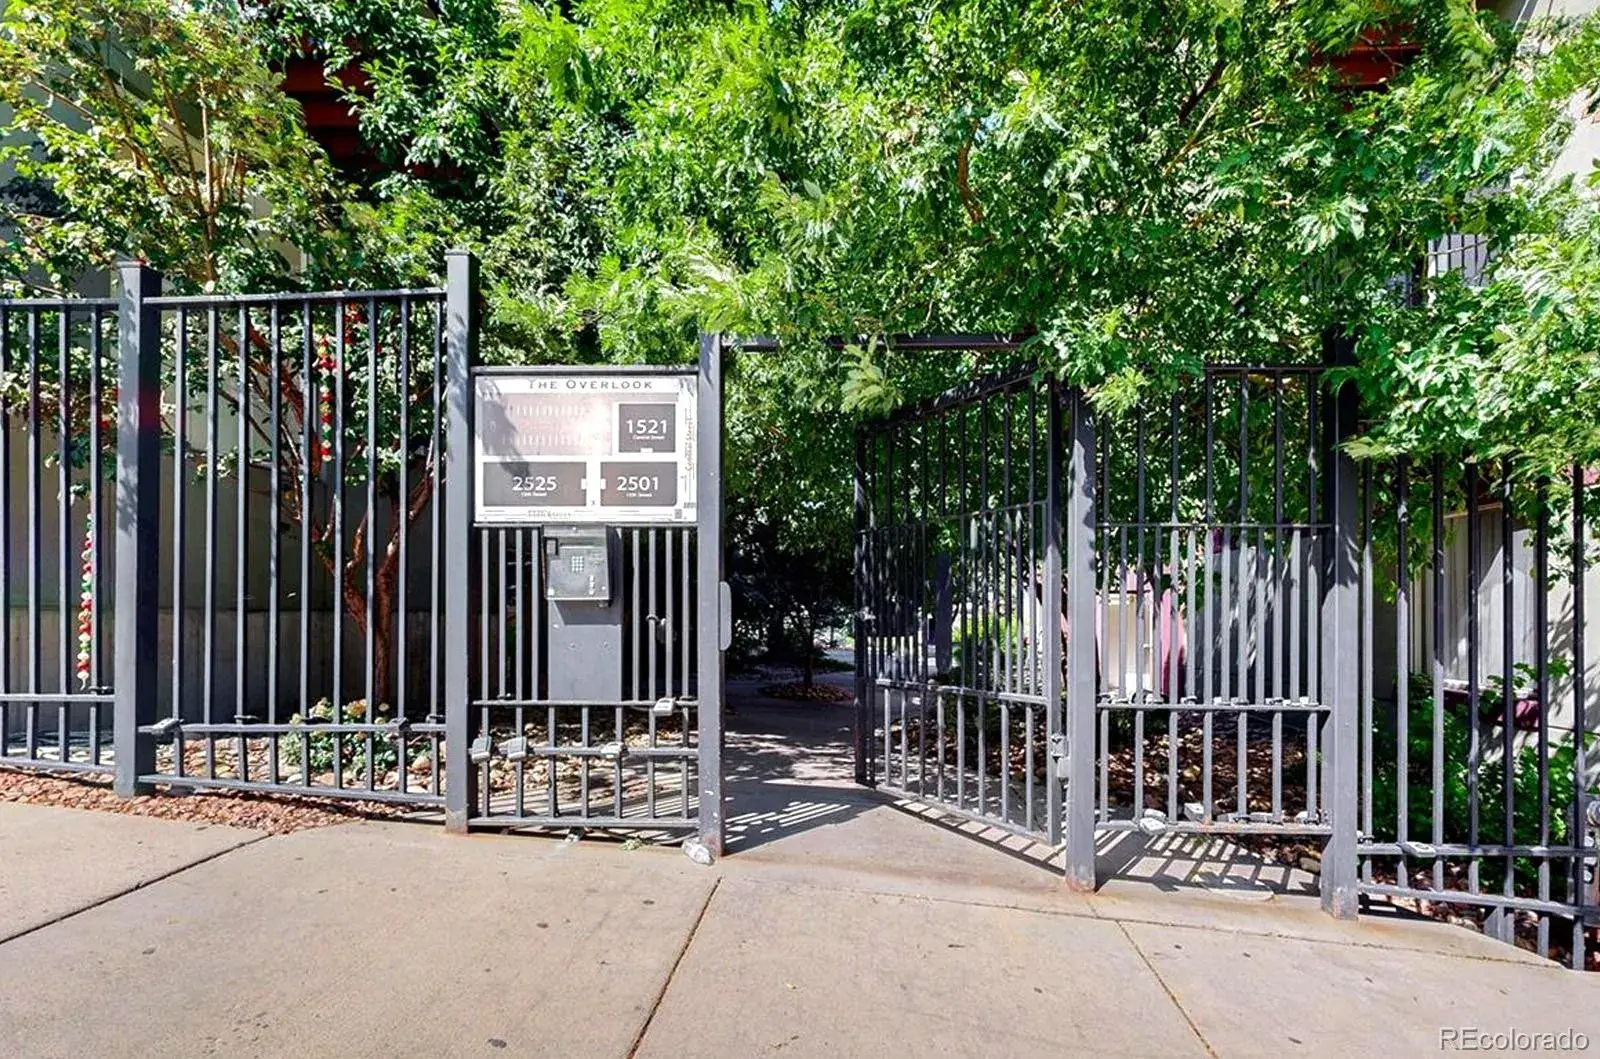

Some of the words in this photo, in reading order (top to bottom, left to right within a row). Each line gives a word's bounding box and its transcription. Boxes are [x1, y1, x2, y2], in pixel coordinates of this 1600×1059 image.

[626, 419, 668, 435] 1521
[511, 476, 558, 491] 2525
[617, 476, 659, 491] 2501
